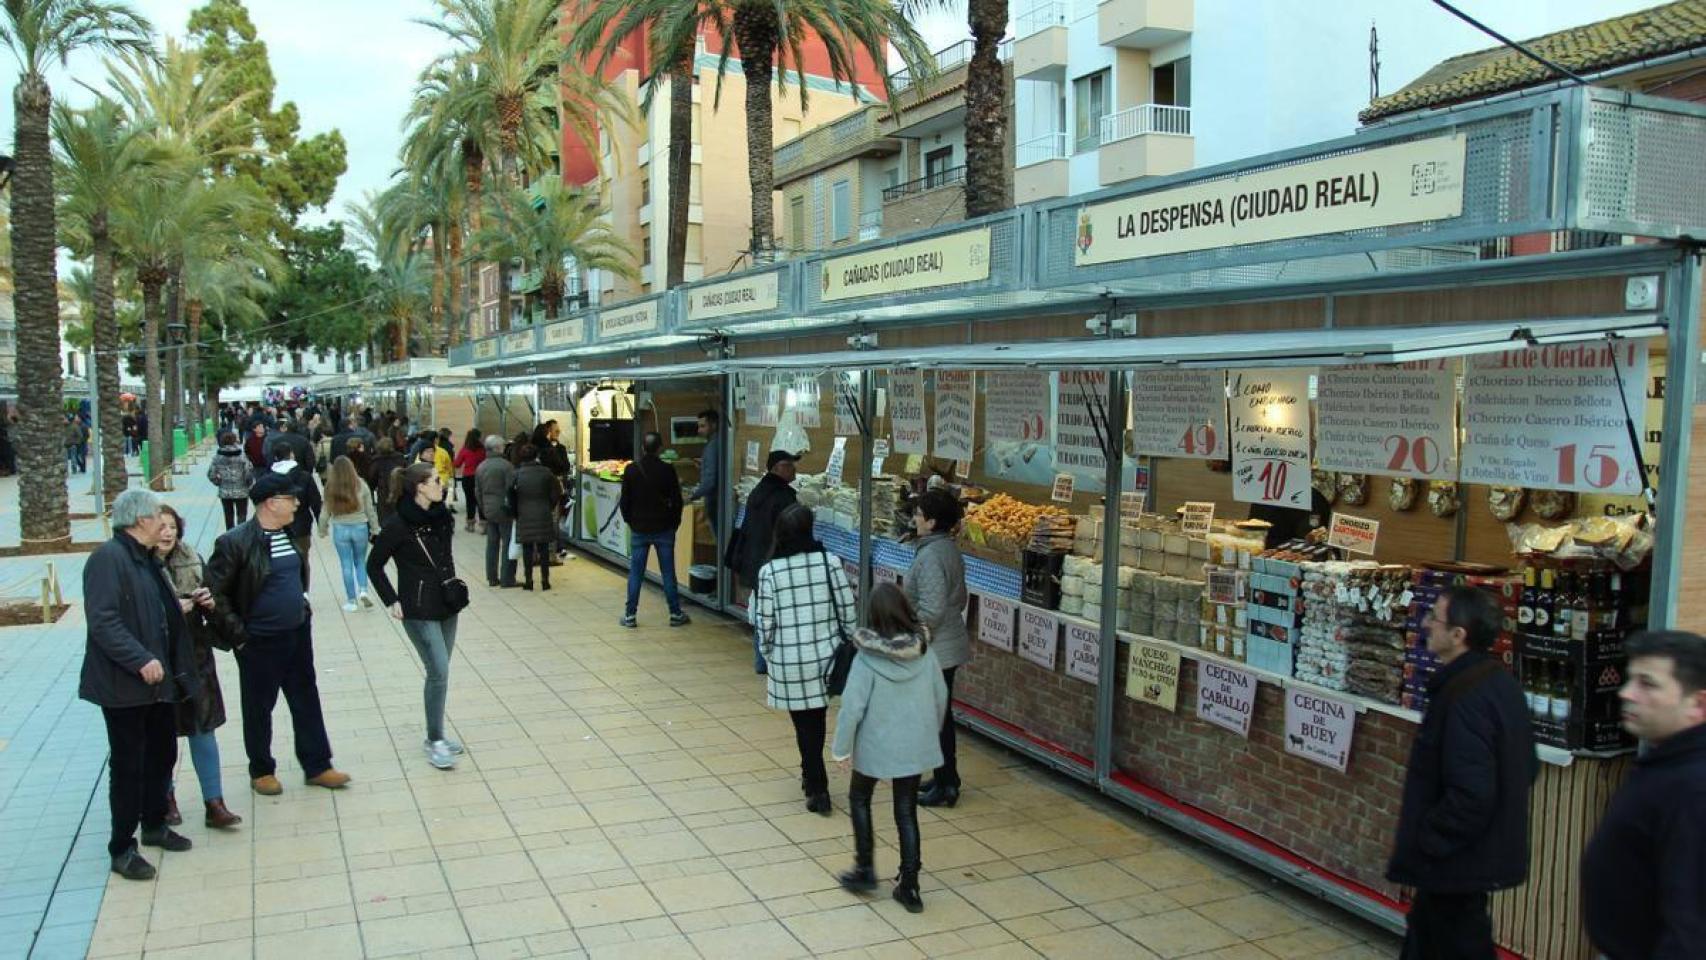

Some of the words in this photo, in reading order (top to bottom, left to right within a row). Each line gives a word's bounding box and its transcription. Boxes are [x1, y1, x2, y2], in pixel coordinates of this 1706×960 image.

[1117, 215, 1136, 239] LA
[1140, 198, 1225, 236] DESPENSA
[1230, 184, 1309, 229] (CIUDAD
[1315, 171, 1380, 209] REAL)
[843, 262, 879, 287] CAÑADAS
[880, 256, 915, 283] (CIUDAD
[916, 251, 944, 274] REAL)
[1234, 373, 1242, 397] 1
[1235, 416, 1241, 432] 1
[1524, 414, 1570, 426] Casero
[1178, 424, 1216, 455] 49
[1384, 434, 1440, 474] 20
[1553, 443, 1620, 489] 15
[1257, 461, 1287, 500] 10
[1339, 518, 1370, 530] CHORIZO
[1025, 611, 1053, 631] CECINA
[1028, 632, 1047, 650] BUEY
[1142, 646, 1168, 661] QUESO
[1132, 655, 1177, 677] MANCHEGO
[1206, 663, 1249, 688] CECINA
[1220, 682, 1232, 694] DE
[1201, 687, 1250, 715] CABALLO
[1294, 693, 1345, 720] CECINA
[1313, 714, 1326, 726] DE
[1301, 722, 1337, 744] BUEY
